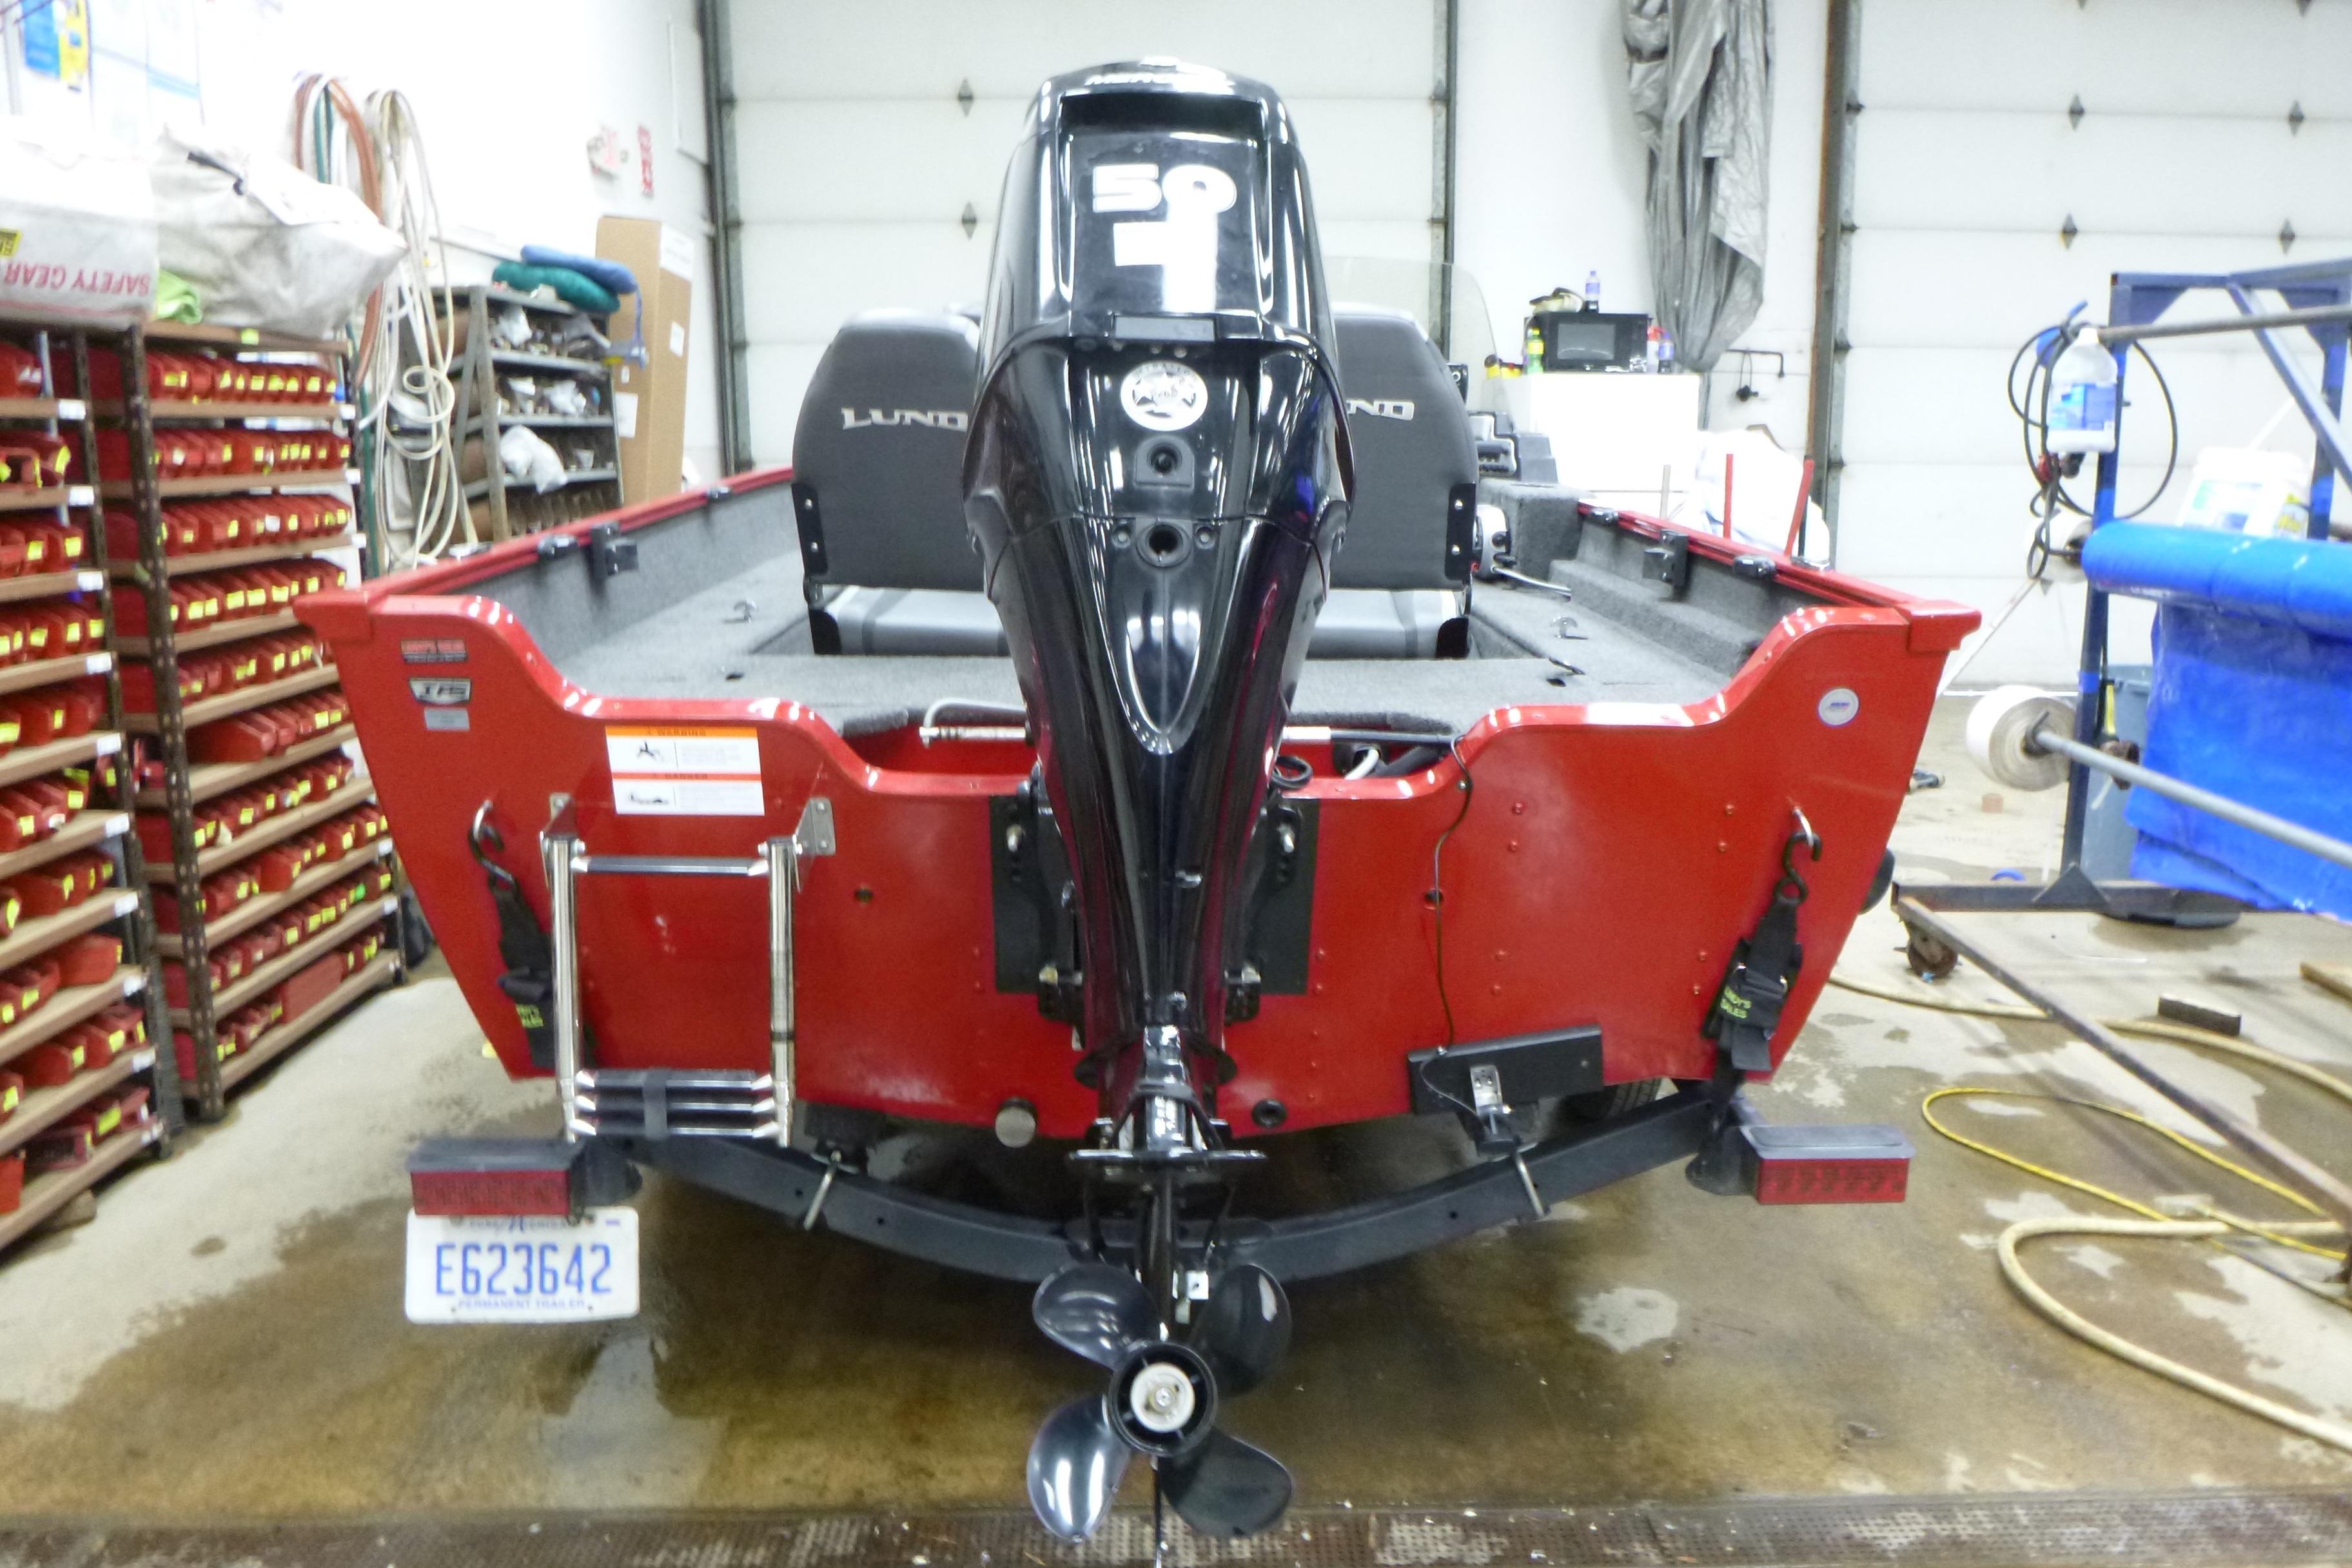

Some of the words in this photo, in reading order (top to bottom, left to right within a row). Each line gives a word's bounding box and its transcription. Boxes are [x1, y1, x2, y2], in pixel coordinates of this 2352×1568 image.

[1092, 163, 1237, 213] 50
[4, 262, 67, 289] GEAR
[71, 268, 150, 297] SAFETY
[841, 407, 968, 432] LUND
[1345, 398, 1415, 421] ND
[435, 1241, 612, 1295] E623642
[458, 1298, 531, 1310] PERMANENT
[535, 1298, 585, 1309] TRAILER
